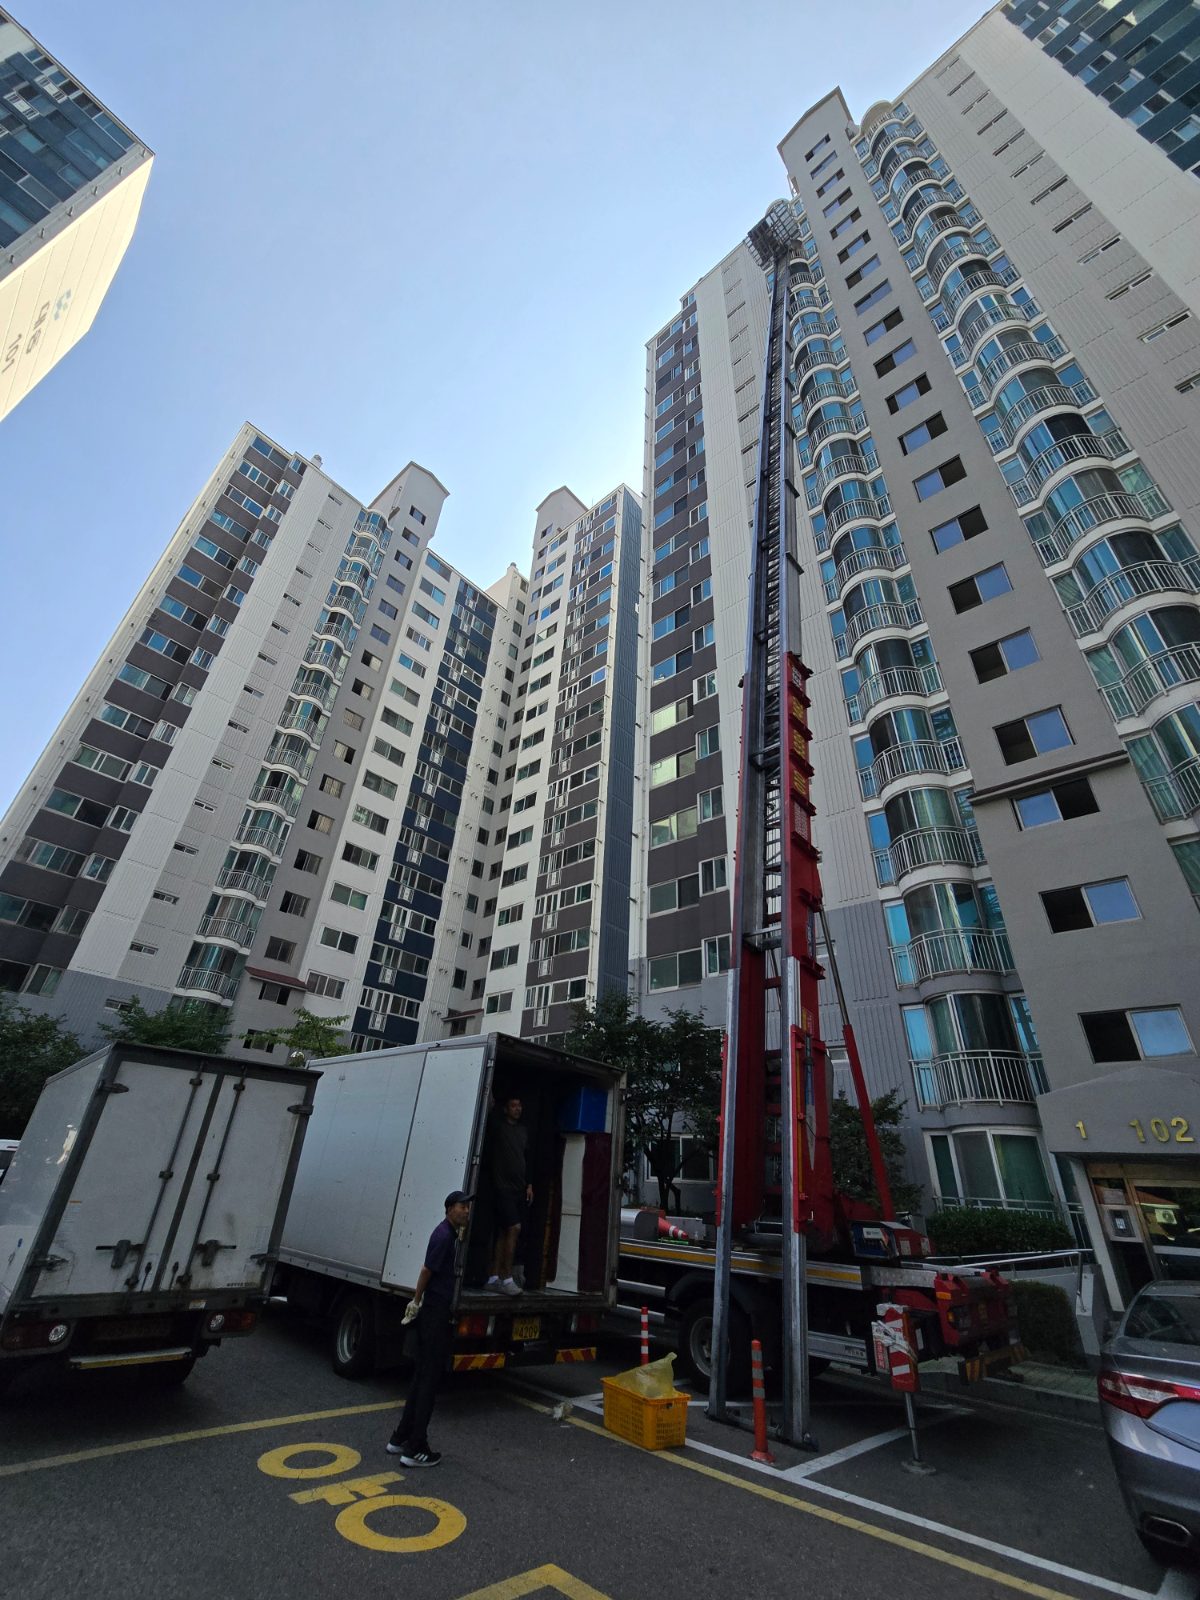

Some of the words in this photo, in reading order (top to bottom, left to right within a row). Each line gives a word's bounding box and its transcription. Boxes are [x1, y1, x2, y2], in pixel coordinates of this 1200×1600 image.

[1, 333, 22, 374] 101
[1075, 1119, 1088, 1140] 1
[1129, 1115, 1195, 1143] 102
